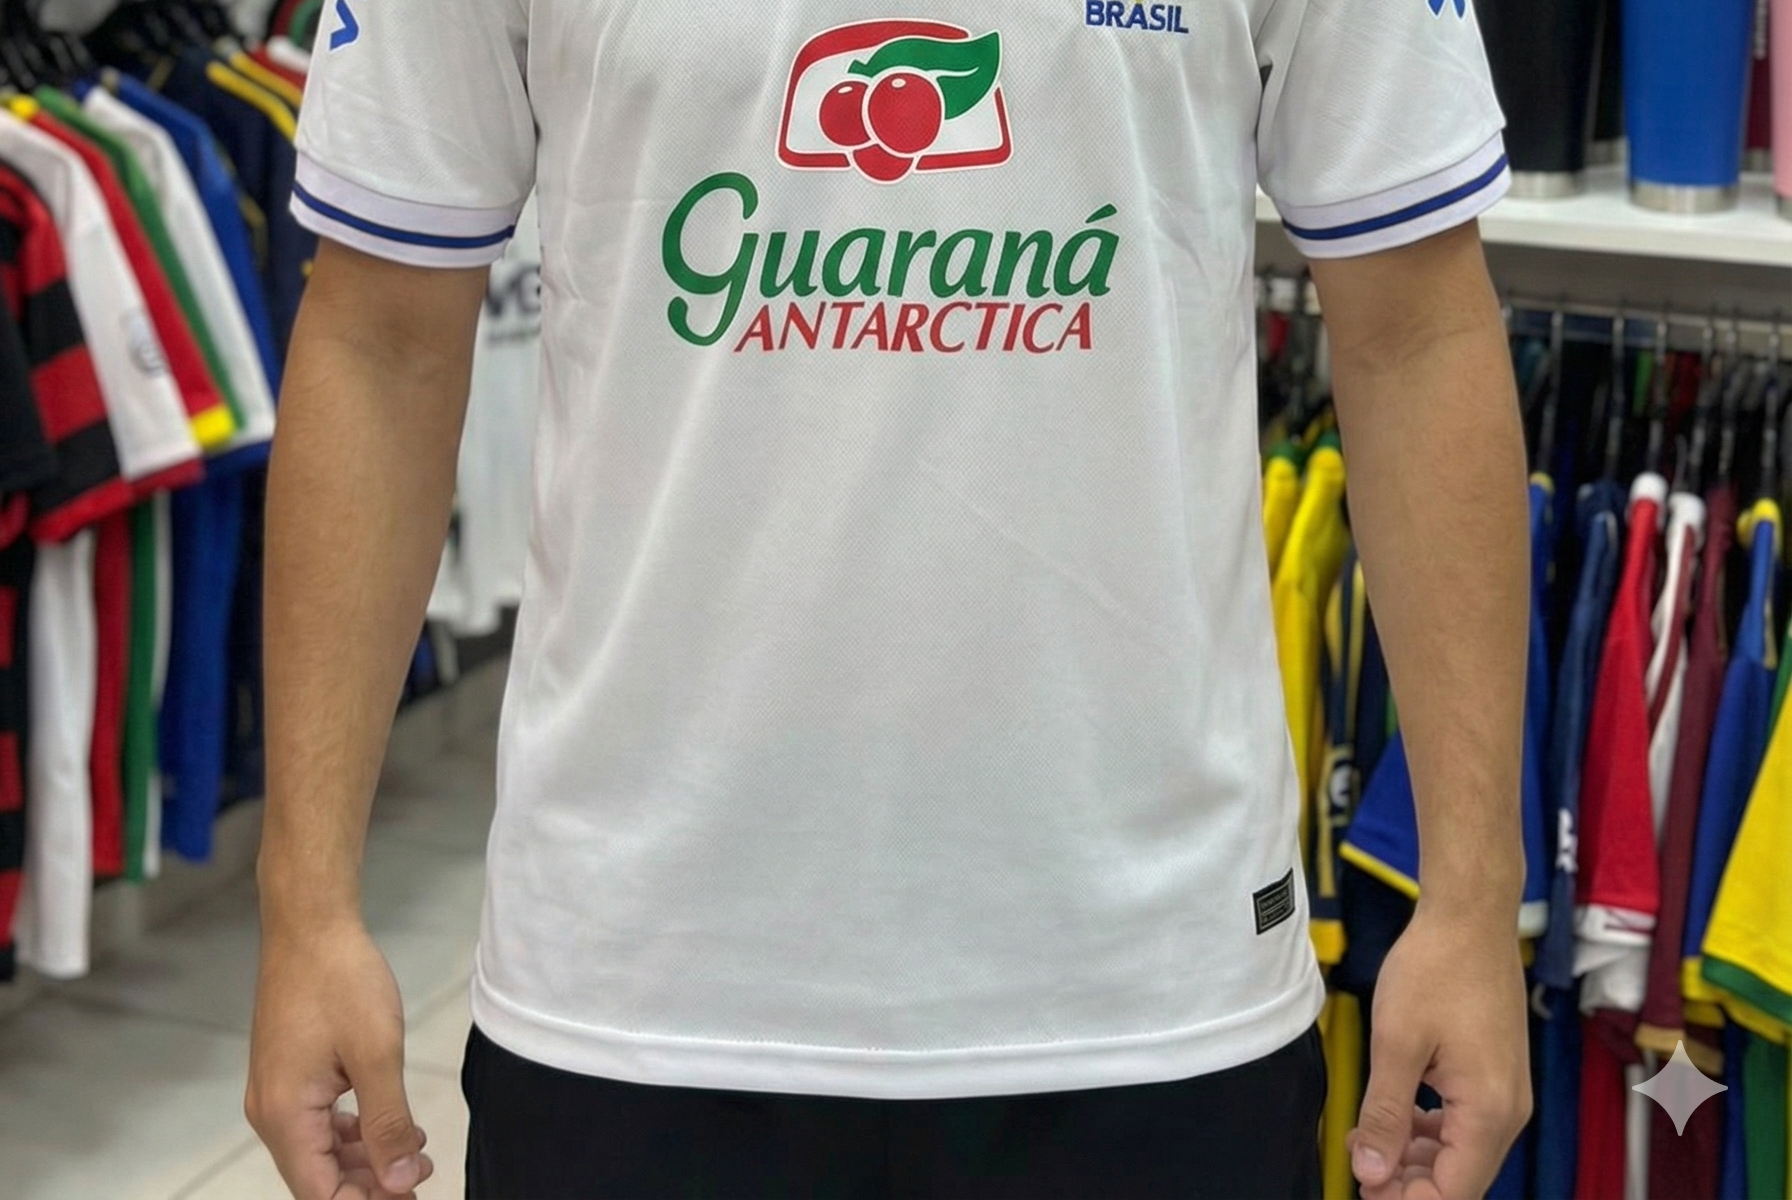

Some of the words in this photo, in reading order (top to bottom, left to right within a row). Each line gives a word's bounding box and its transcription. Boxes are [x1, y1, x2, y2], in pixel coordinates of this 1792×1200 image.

[1085, 0, 1189, 34] BRASIL
[662, 172, 1120, 346] Guaraná
[734, 301, 1093, 353] ANTARCTICA
